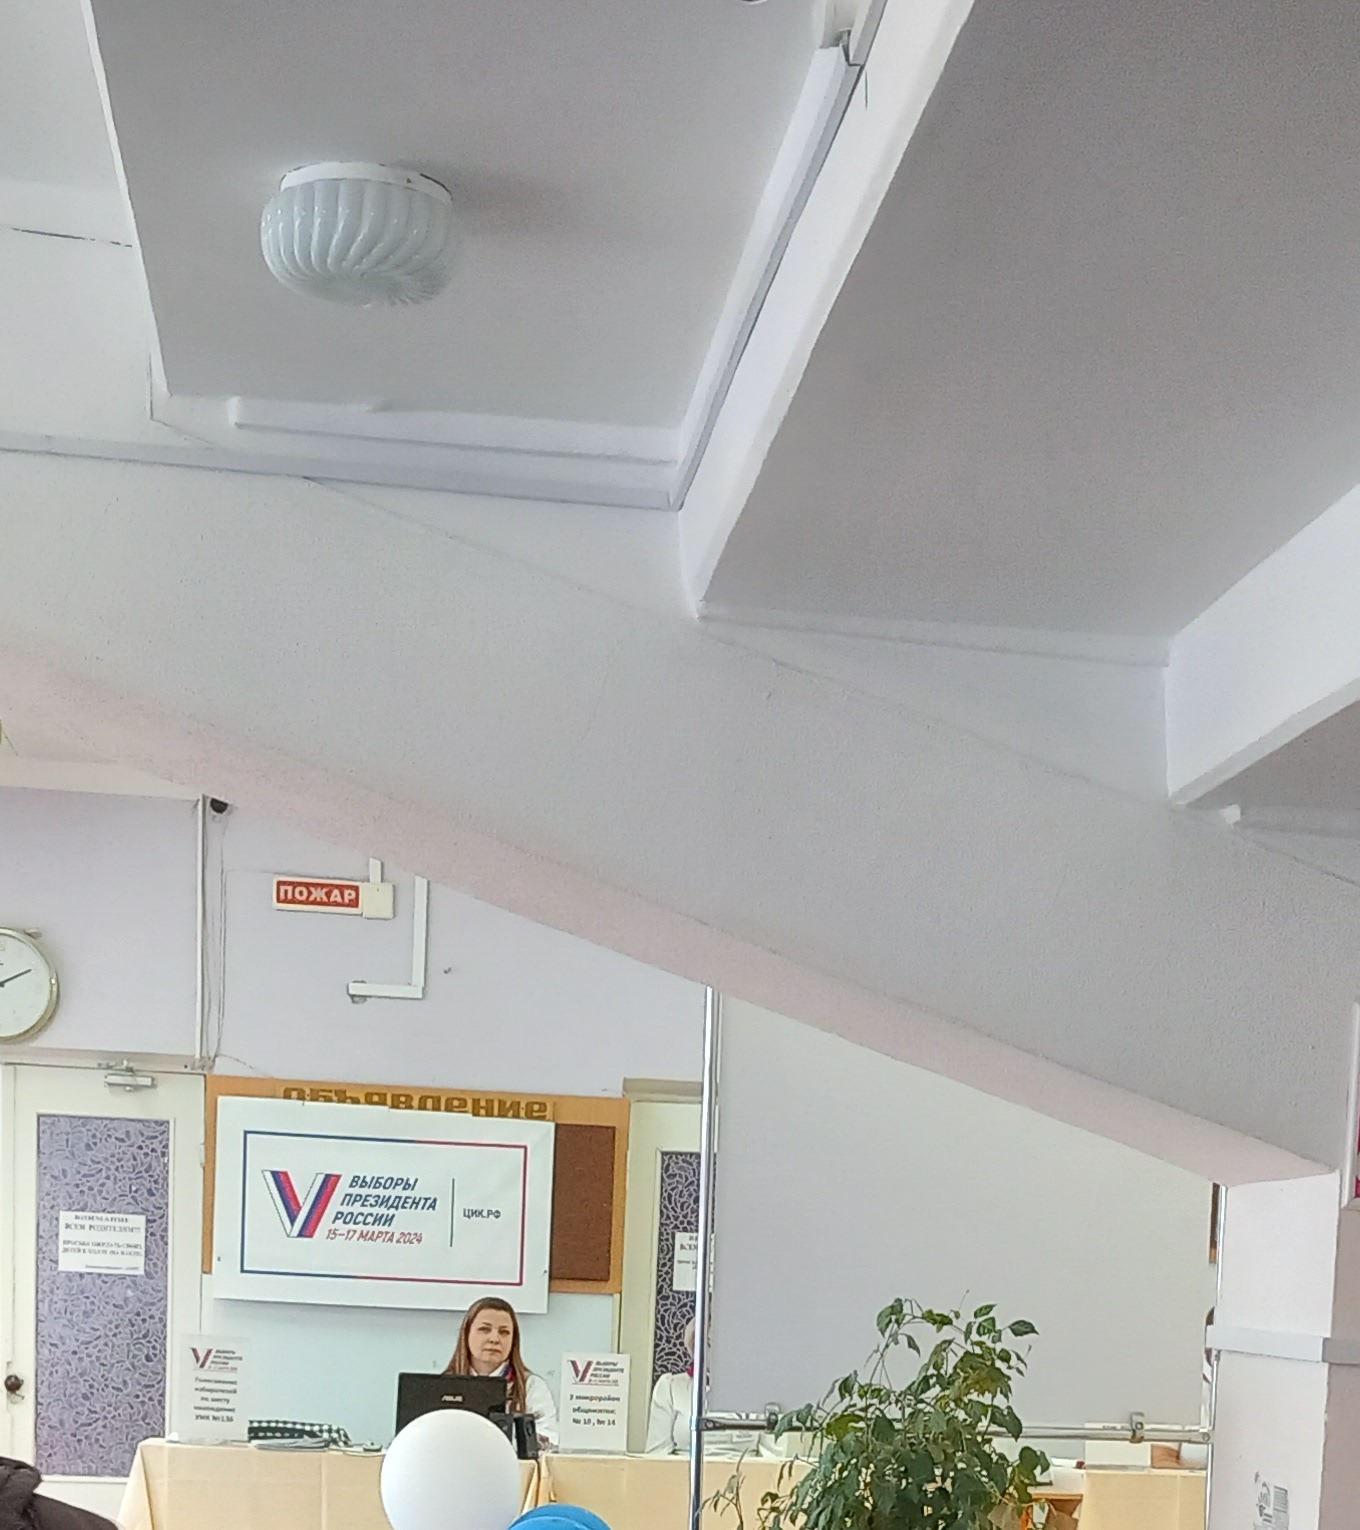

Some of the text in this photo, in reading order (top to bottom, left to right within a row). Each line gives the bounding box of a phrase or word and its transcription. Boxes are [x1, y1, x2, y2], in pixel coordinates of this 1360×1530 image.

[279, 885, 357, 904] ПОЖАР
[348, 1175, 418, 1191] ВЫБОРЫ
[340, 1193, 438, 1211] ПРЕЗИДЕНТА
[332, 1211, 395, 1227] РОССИИ
[463, 1208, 501, 1219] ЦИК.РФ
[357, 1230, 395, 1243] МАРТА
[396, 1231, 423, 1244] 2024
